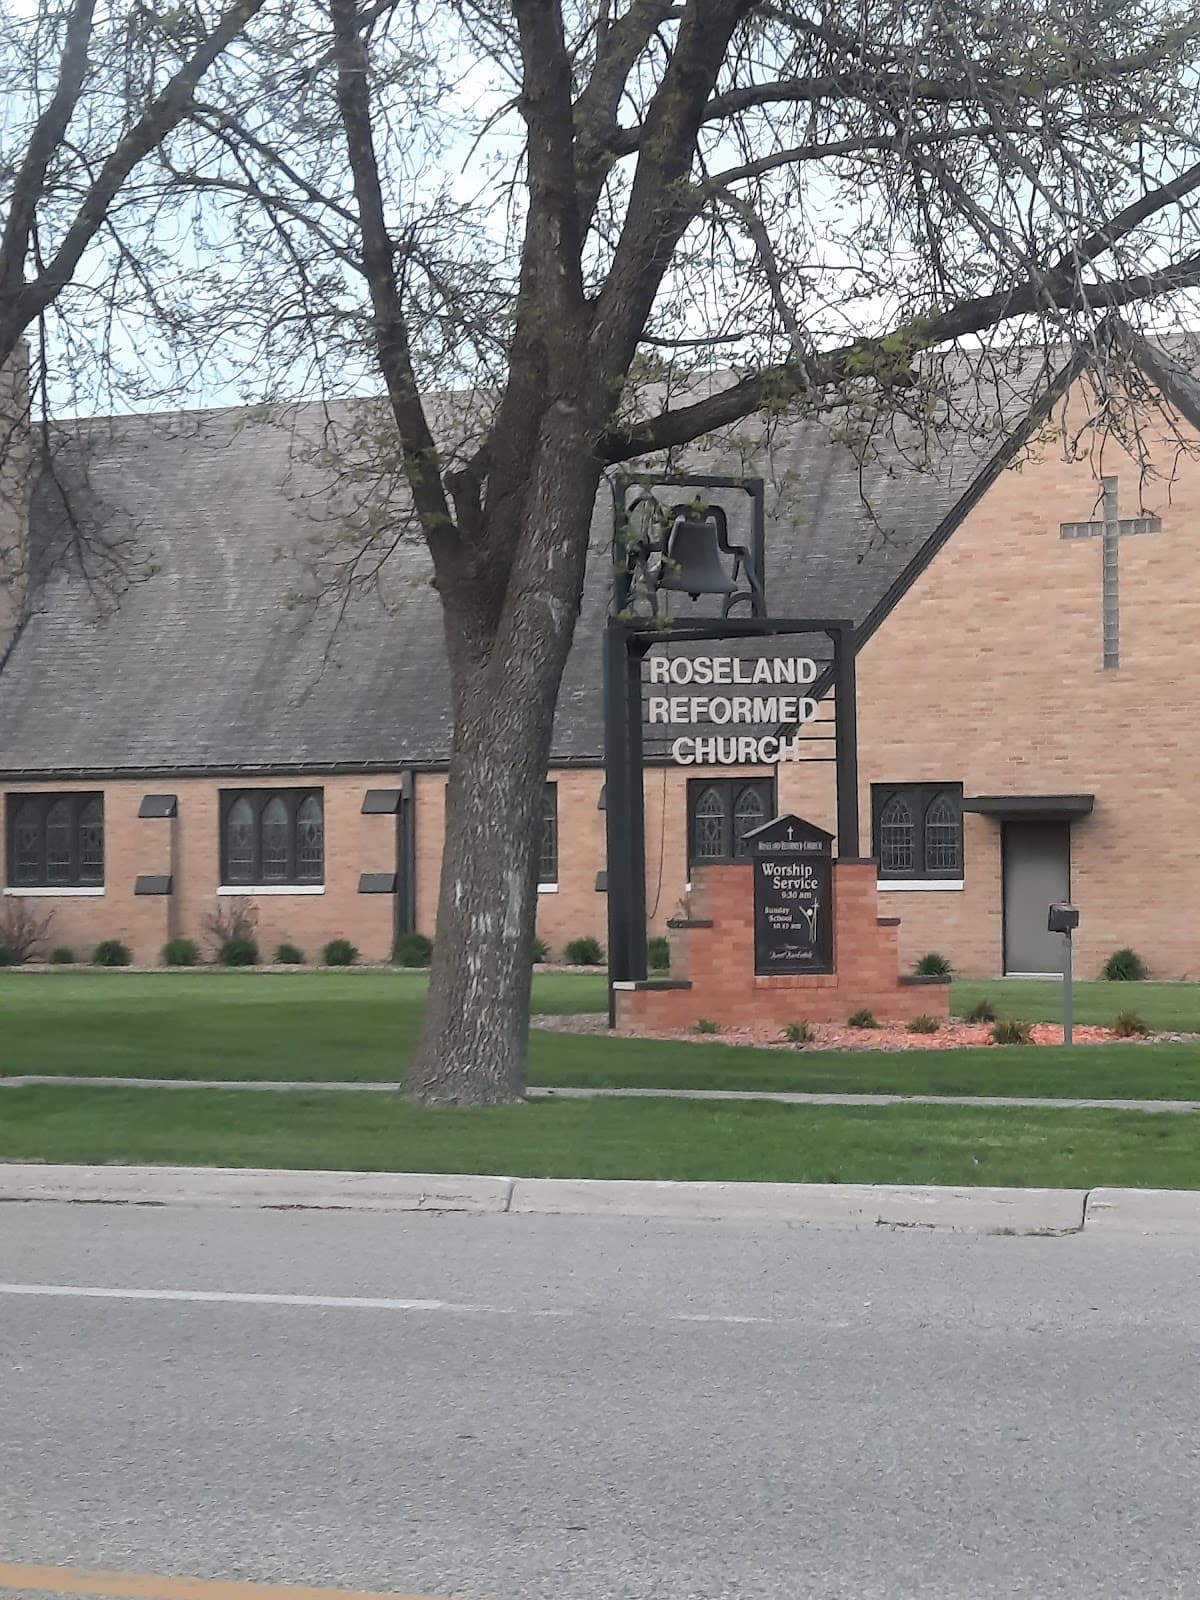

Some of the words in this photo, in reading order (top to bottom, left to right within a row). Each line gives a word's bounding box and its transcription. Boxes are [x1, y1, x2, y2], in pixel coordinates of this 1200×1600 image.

[650, 656, 817, 685] ROSELAND
[649, 697, 818, 725] REFORMED
[672, 736, 800, 765] CHURCH
[762, 863, 813, 878] Worship
[773, 877, 819, 890] Service
